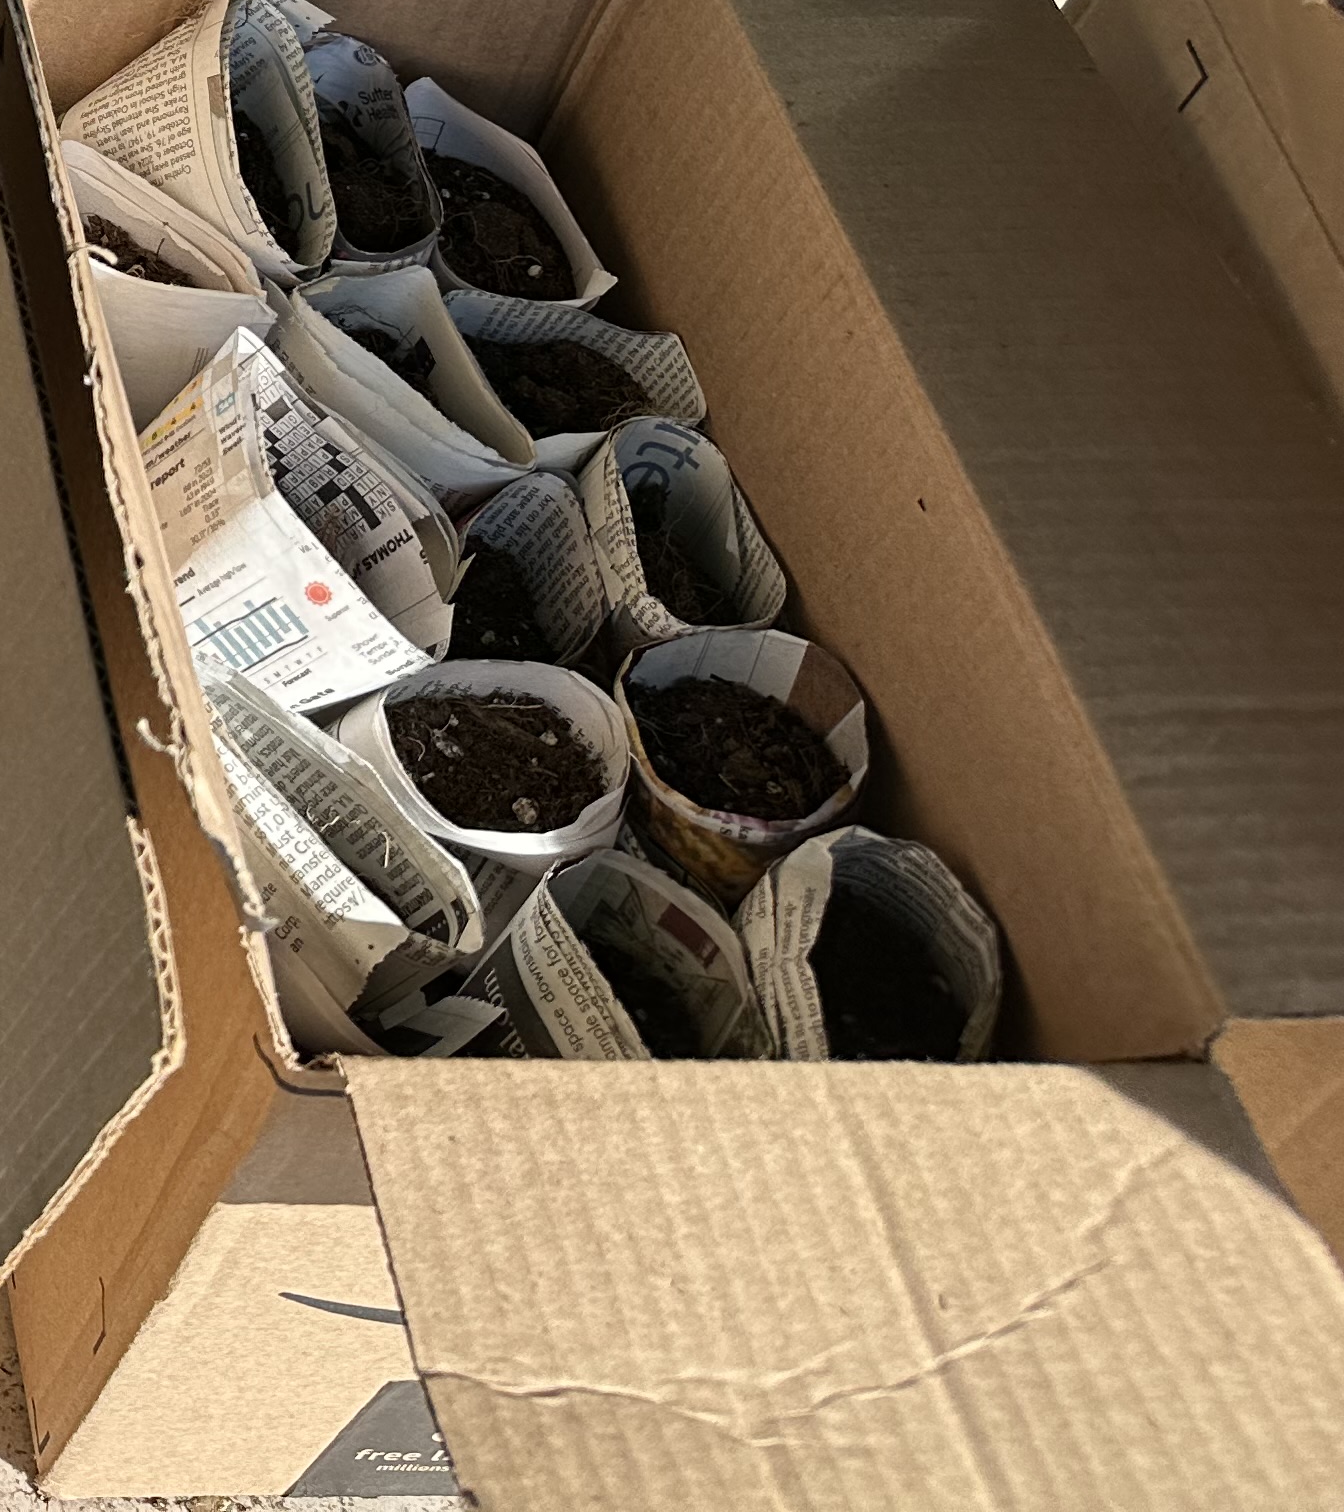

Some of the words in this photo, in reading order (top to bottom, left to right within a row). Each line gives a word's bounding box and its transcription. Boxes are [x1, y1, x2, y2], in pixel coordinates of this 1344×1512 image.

[145, 70, 186, 93] graduated
[167, 83, 187, 96] High
[139, 91, 166, 106] School
[98, 105, 128, 123] Oakland
[145, 104, 160, 114] She
[152, 105, 189, 125] Raymond
[82, 118, 96, 129] and
[112, 110, 142, 130] attended
[136, 119, 150, 131] and
[158, 116, 190, 133] October
[140, 143, 154, 153] She
[163, 139, 194, 156] October
[170, 148, 196, 165] passed
[358, 530, 412, 570] THOMAS
[282, 668, 312, 687] Forecast
[542, 945, 562, 967] for
[558, 963, 595, 1012] space
[554, 1008, 583, 1052] space
[355, 1448, 422, 1462] free
[375, 1463, 450, 1473] millions
